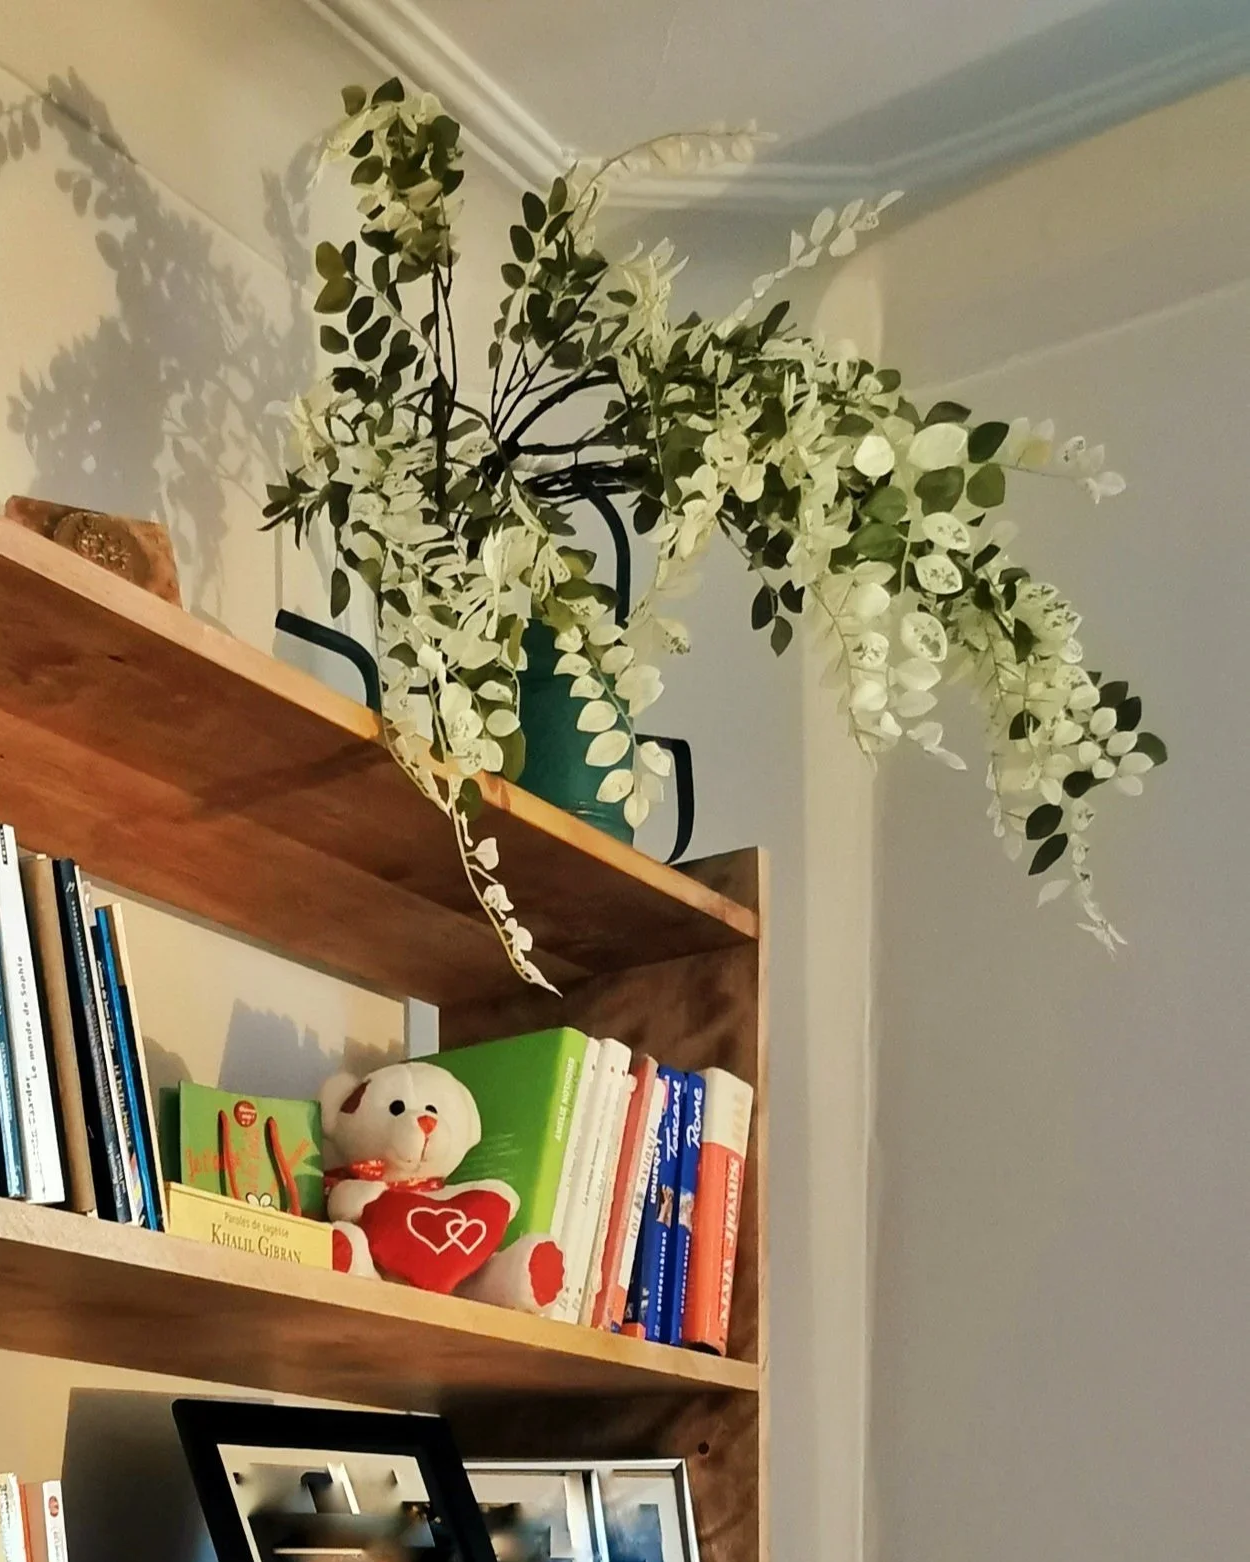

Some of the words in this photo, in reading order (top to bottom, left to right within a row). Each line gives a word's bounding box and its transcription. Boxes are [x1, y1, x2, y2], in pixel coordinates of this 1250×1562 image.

[16, 955, 27, 997] Sophie
[22, 1001, 30, 1015] de
[26, 1020, 36, 1060] monde
[31, 1066, 38, 1079] Le
[665, 1081, 681, 1162] Toscane
[685, 1087, 702, 1149] Rome
[649, 1139, 661, 1203] Lebanon
[211, 1222, 255, 1253] KHALIL
[257, 1235, 302, 1264] GIBRAN
[224, 1211, 251, 1229] Paroles
[252, 1218, 261, 1230] de
[263, 1222, 289, 1237] sagesse
